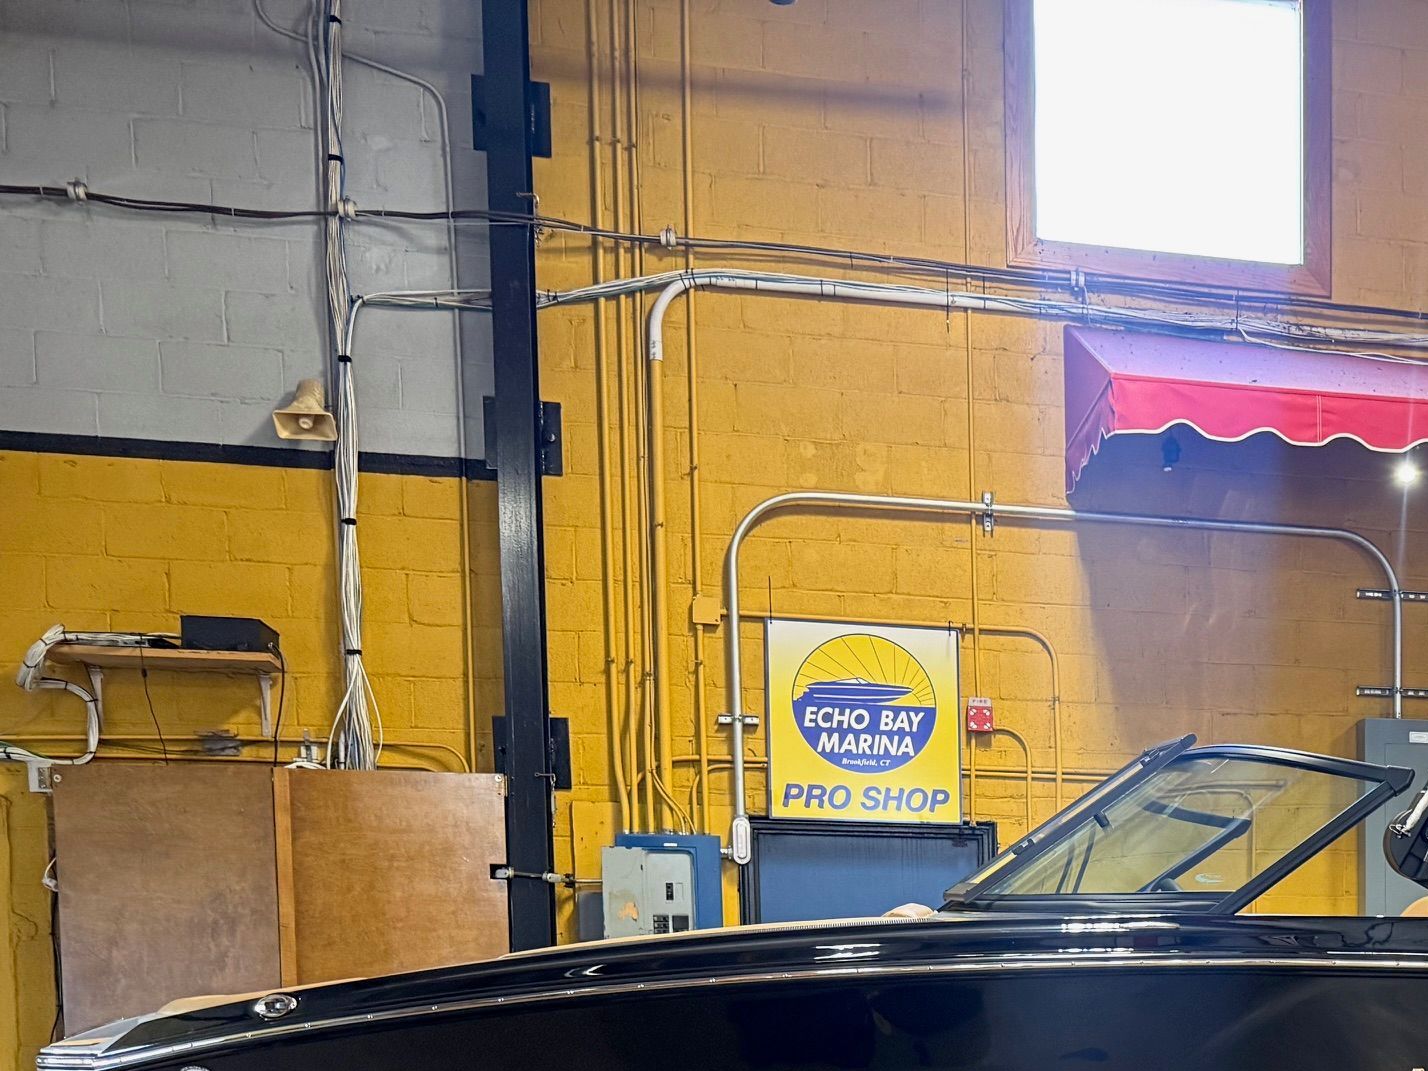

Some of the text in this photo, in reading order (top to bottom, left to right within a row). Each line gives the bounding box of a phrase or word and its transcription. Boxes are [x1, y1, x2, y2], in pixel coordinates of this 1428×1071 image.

[804, 706, 925, 732] ECHO BAY
[817, 733, 915, 757] MARINA
[782, 783, 951, 813] PRO SHOP
